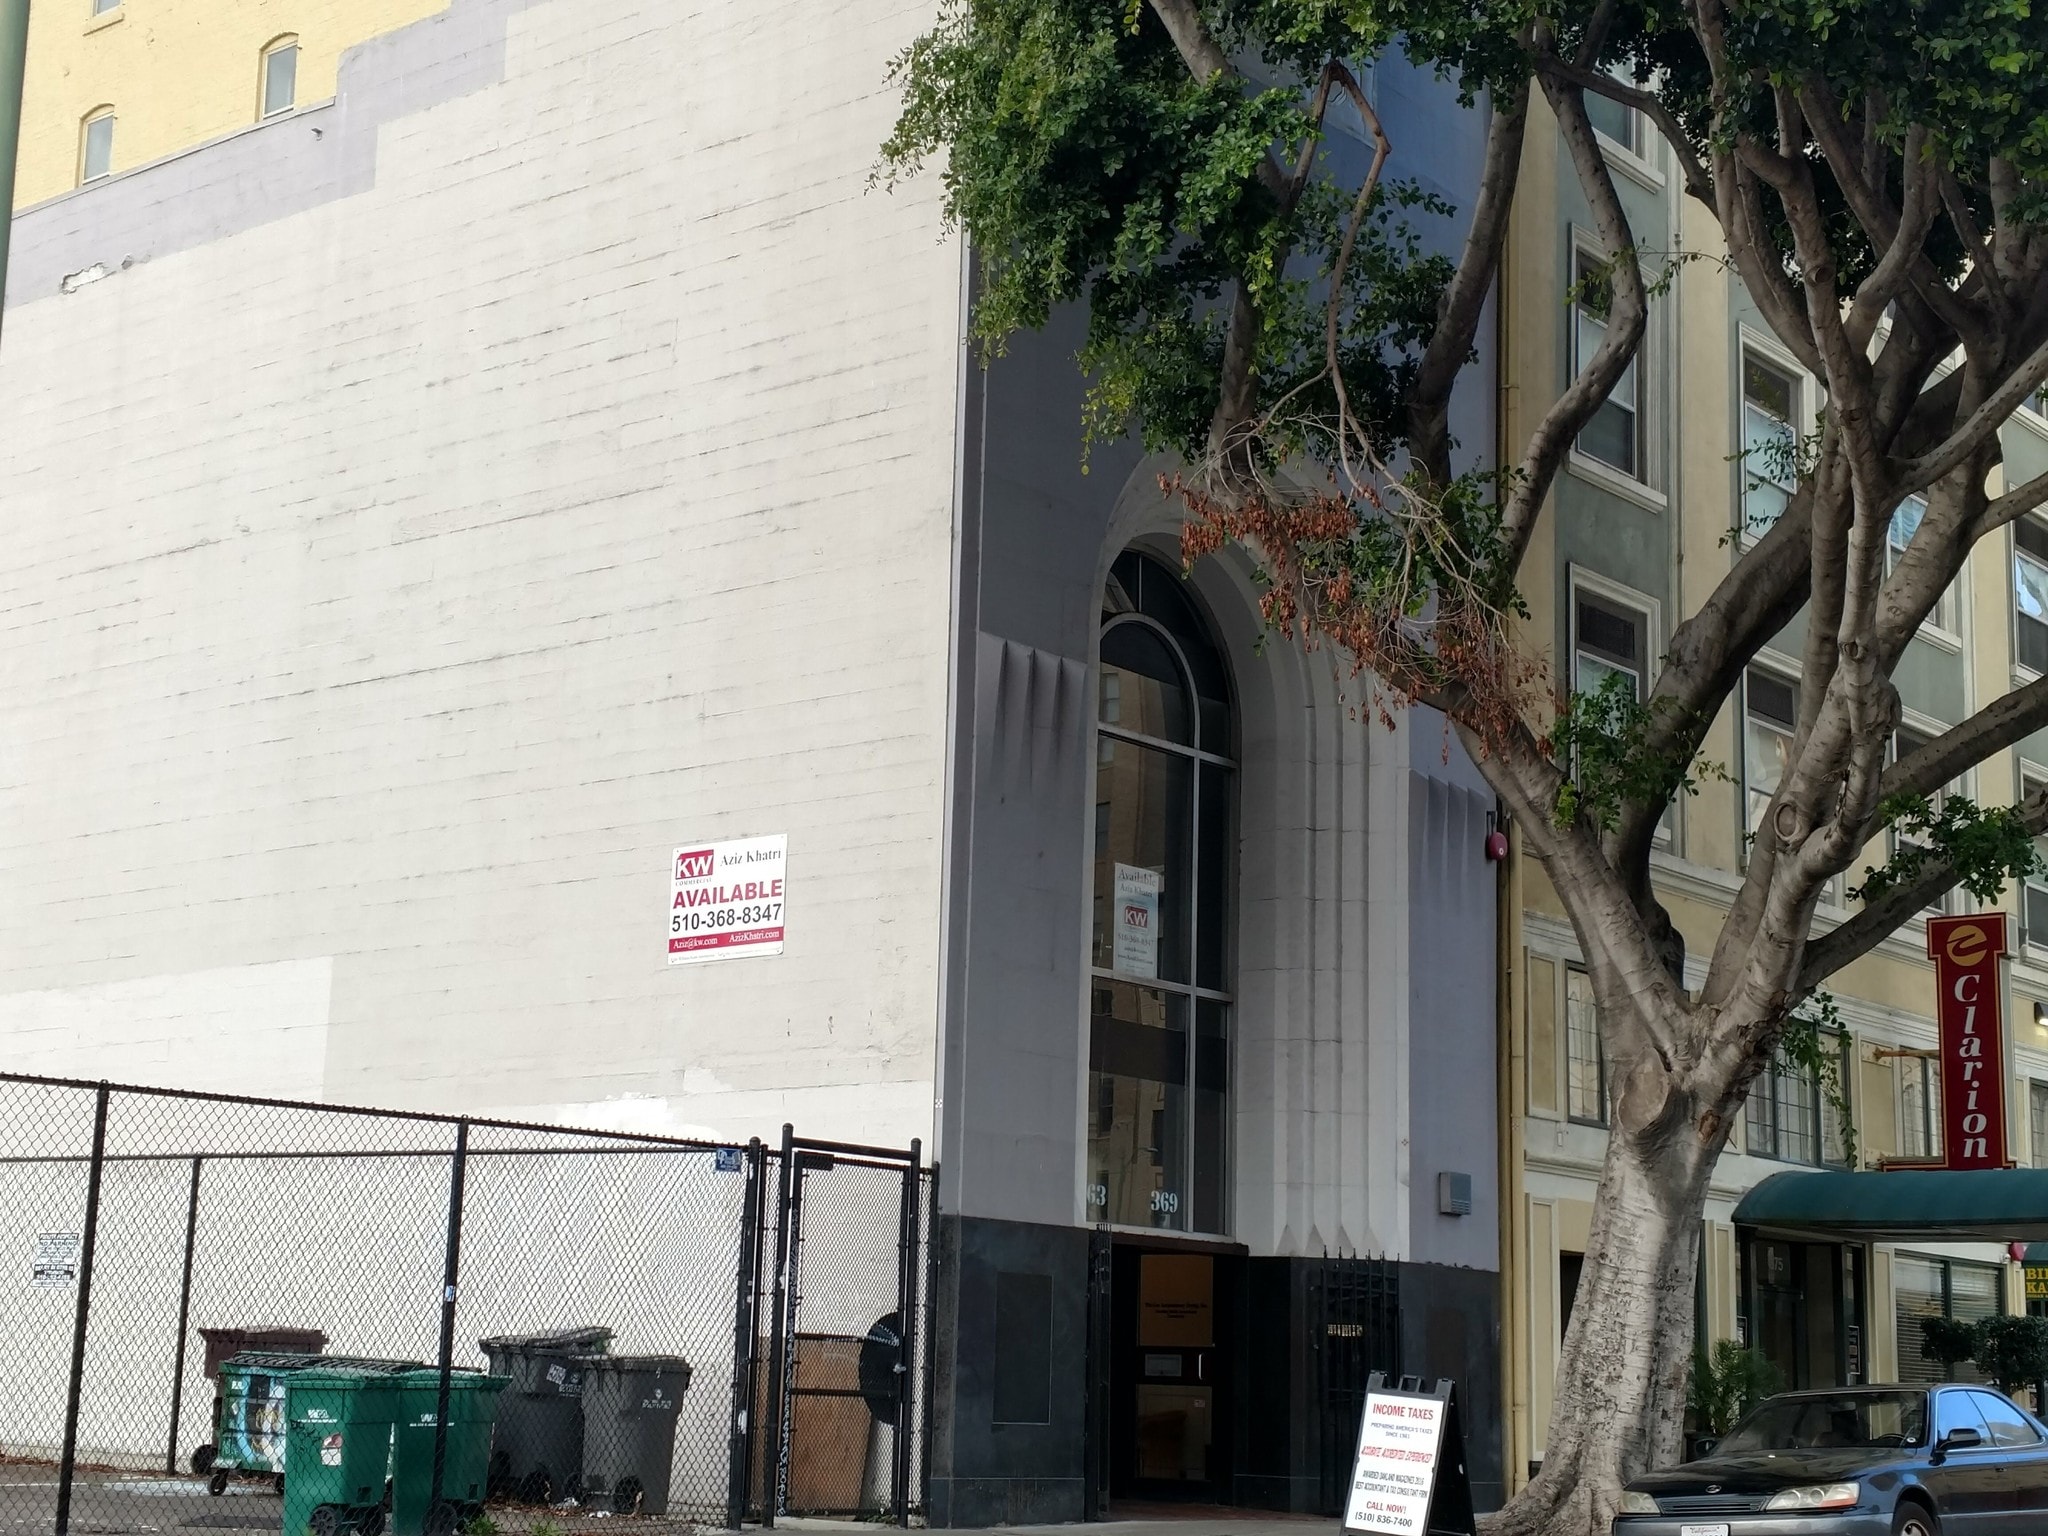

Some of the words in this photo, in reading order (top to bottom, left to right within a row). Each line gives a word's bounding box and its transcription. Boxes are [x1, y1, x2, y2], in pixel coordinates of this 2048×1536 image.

[677, 855, 712, 879] KW
[720, 852, 743, 867] Aziz
[746, 849, 781, 863] Khatri
[1118, 869, 1156, 887] Available
[673, 879, 783, 909] AVAILABLE
[672, 903, 782, 932] 510-368-8347
[1125, 909, 1147, 927] KW
[729, 930, 780, 943] AzizKhatri.com
[1954, 974, 1988, 1158] Clarion
[1151, 1190, 1178, 1213] 369
[2026, 1281, 2048, 1294] KA
[1373, 1403, 1405, 1417] INCOME
[1408, 1407, 1434, 1420] TAXES
[1366, 1500, 1384, 1511] CALL
[1386, 1502, 1407, 1515] NOW!
[1355, 1511, 1375, 1523] (510)
[1376, 1513, 1413, 1527] 836-7400
